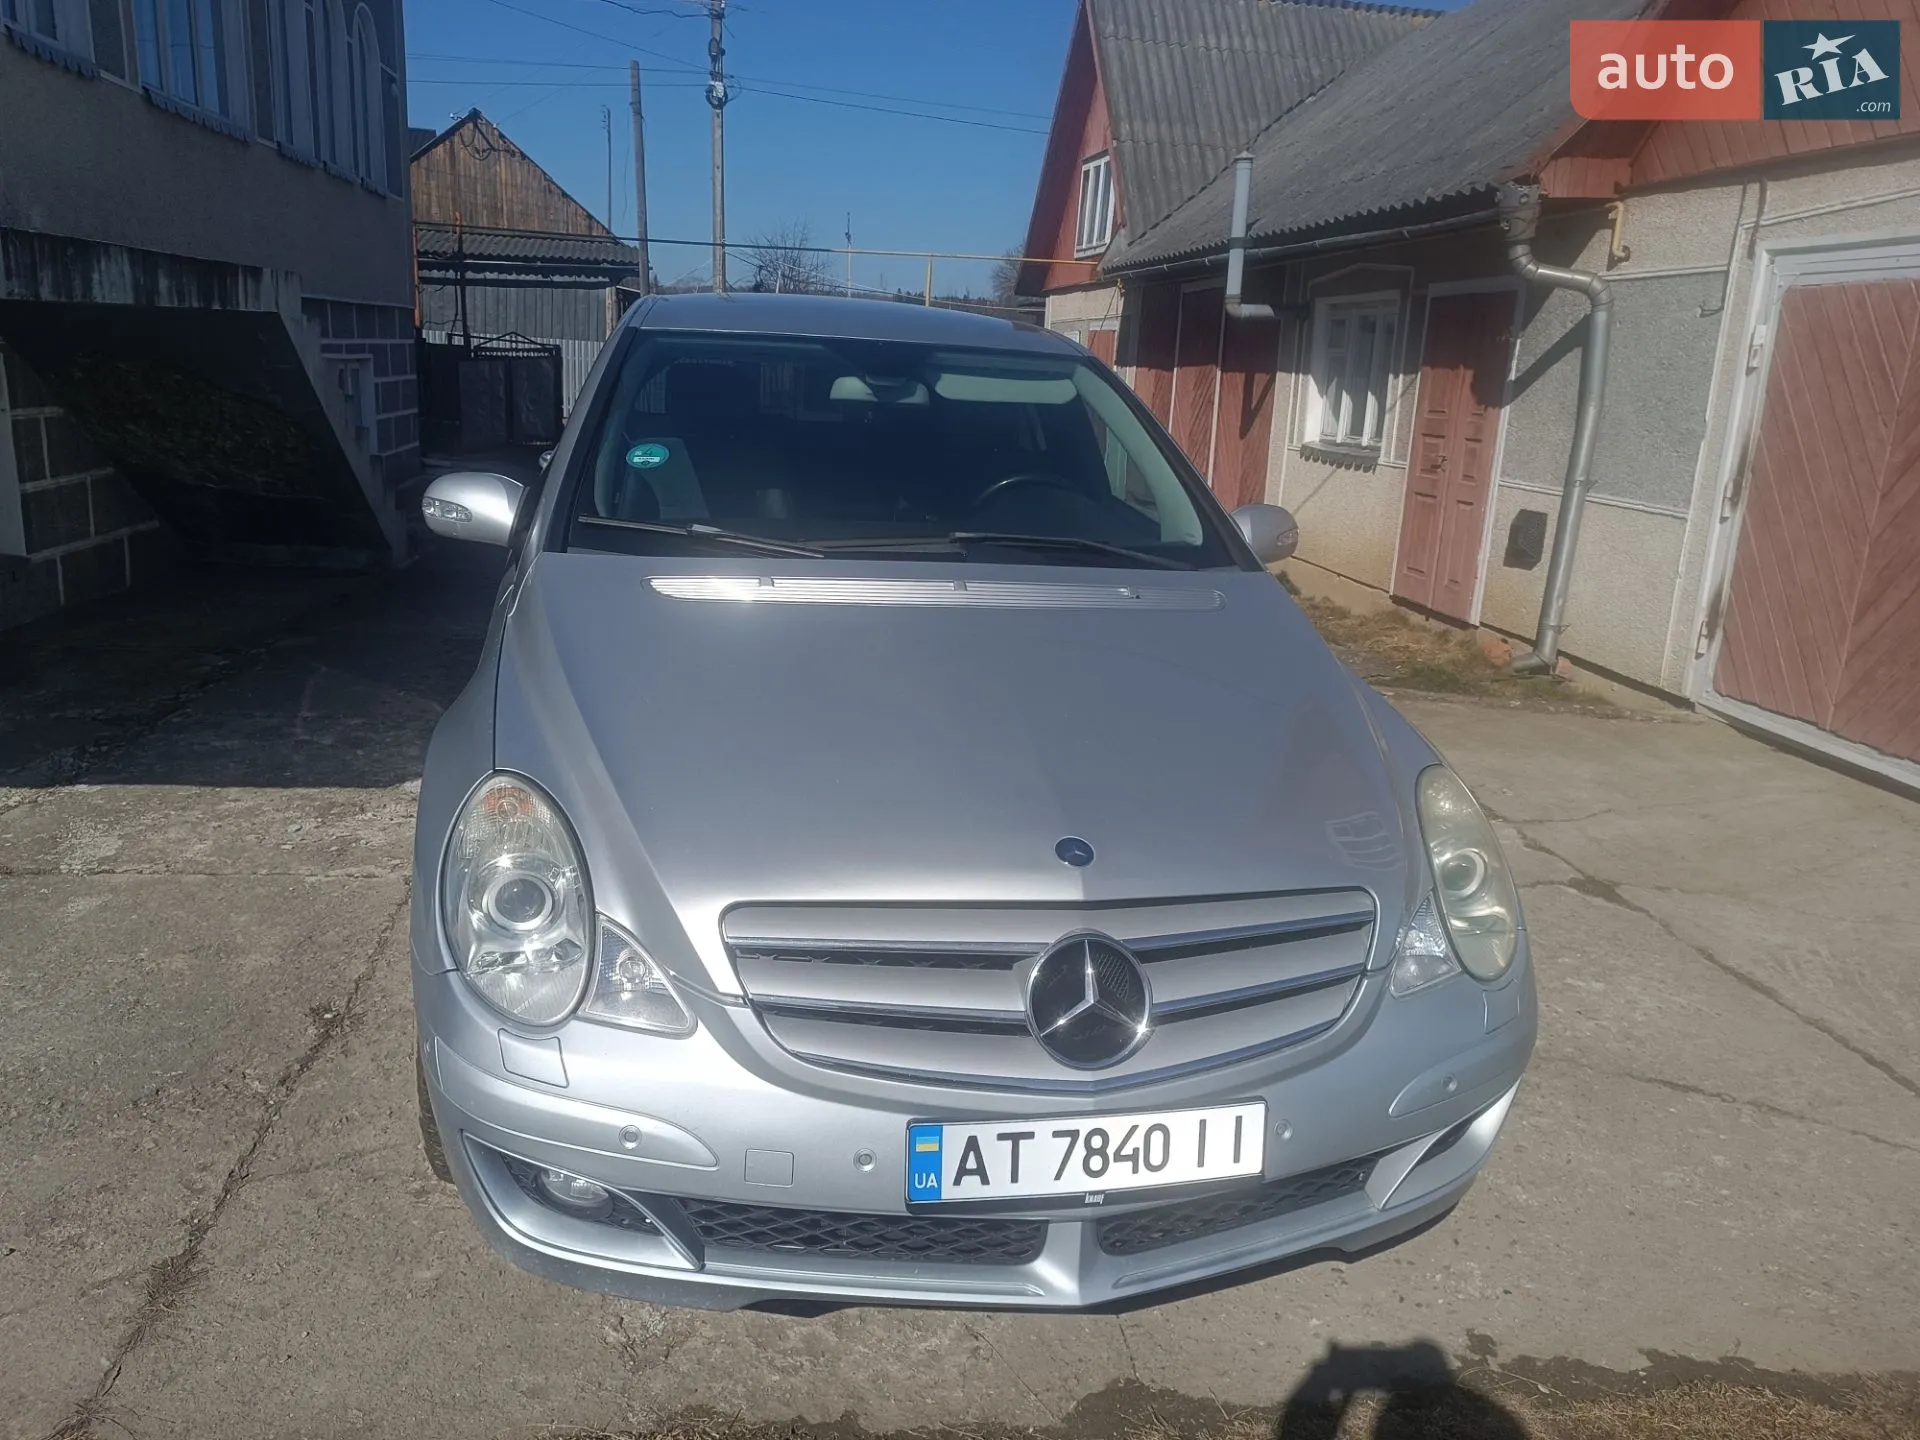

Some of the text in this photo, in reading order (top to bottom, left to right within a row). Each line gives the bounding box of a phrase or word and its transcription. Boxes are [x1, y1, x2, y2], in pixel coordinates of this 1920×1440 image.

[952, 1130, 1035, 1187] AT
[1051, 1122, 1171, 1181] 7840
[914, 1172, 938, 1189] UA
